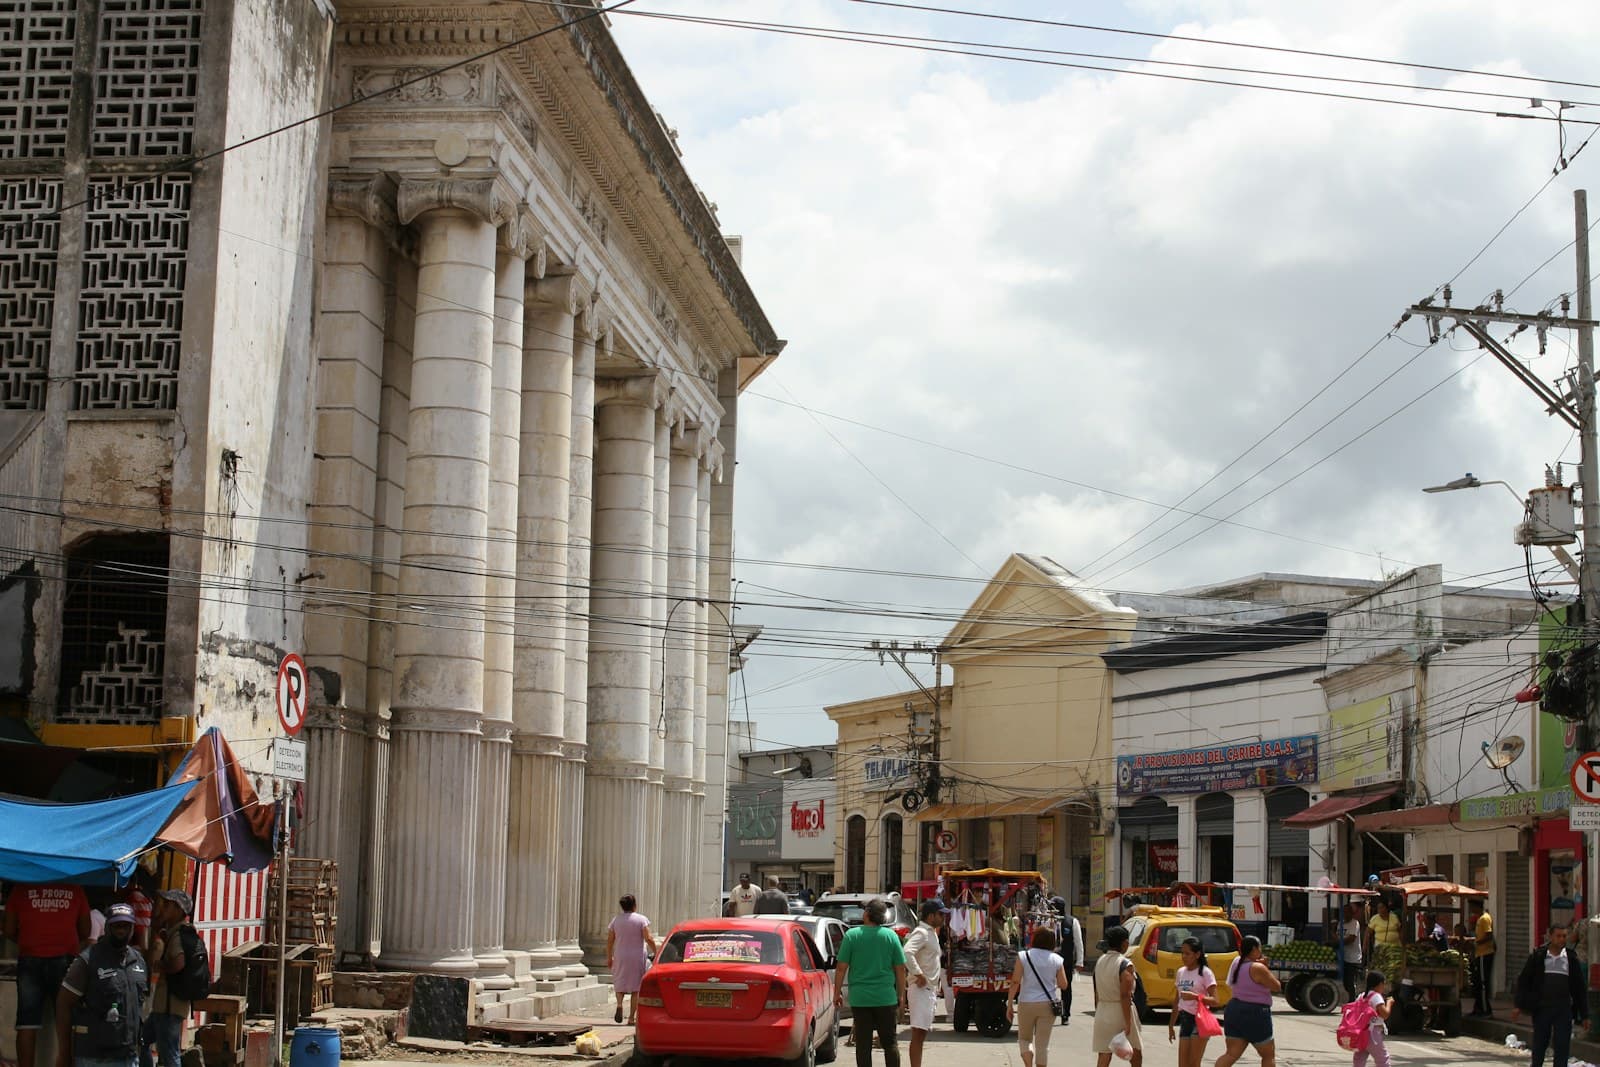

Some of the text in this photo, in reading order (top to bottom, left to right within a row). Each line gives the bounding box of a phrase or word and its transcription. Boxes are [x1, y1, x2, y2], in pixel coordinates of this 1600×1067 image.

[1144, 751, 1205, 768] PROVISIONES
[1207, 747, 1225, 764] DEL
[1227, 743, 1262, 761] CARIBE
[1500, 797, 1536, 816] PELUCHES
[28, 889, 73, 899] EL PROPIO
